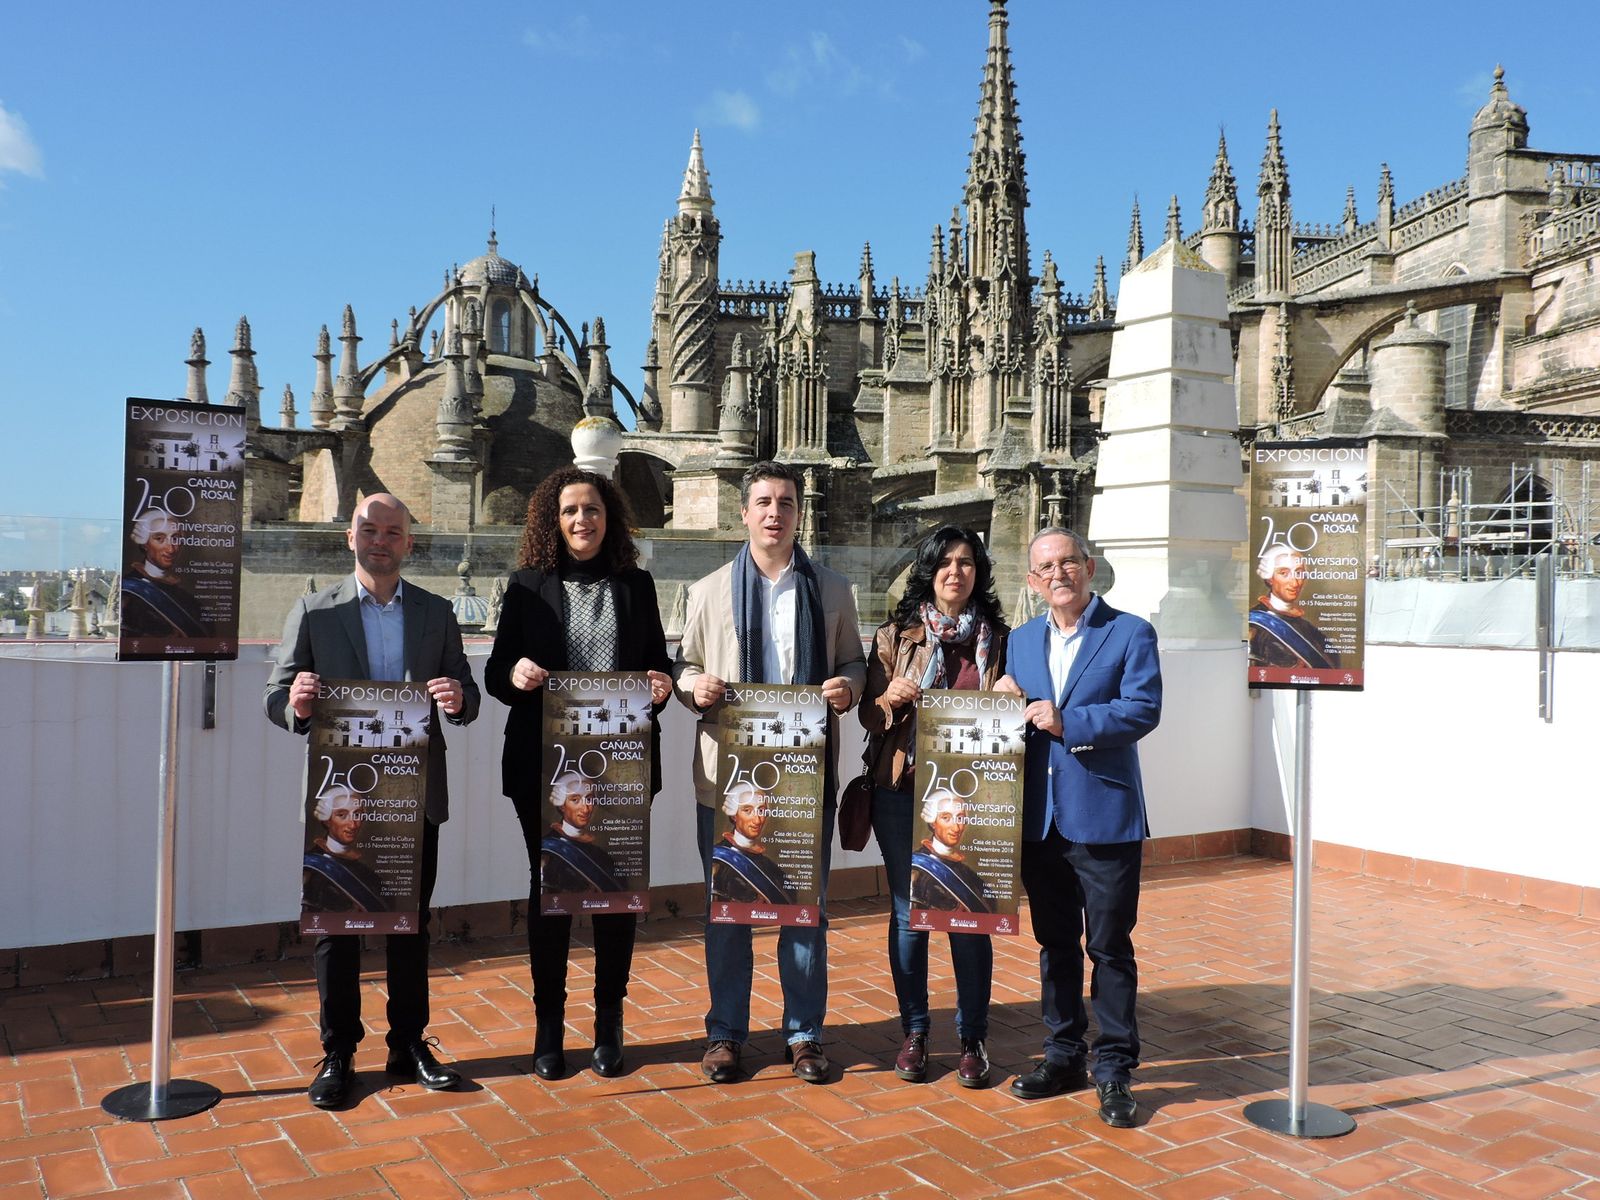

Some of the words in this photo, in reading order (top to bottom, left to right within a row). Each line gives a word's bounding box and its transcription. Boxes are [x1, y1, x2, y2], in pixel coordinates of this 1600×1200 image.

[188, 476, 236, 490] CAÑADA
[201, 490, 236, 501] ROSAL
[132, 477, 195, 532] 250
[1310, 512, 1359, 522] CAÑADA
[172, 519, 235, 533] aniversario
[1323, 524, 1358, 533] ROSAL
[1258, 516, 1317, 566] 250
[1296, 554, 1358, 566] aniversario
[548, 675, 649, 691] EXPOSICIÓN
[318, 686, 427, 702] EXPOSICIÓN
[724, 688, 824, 705] EXPOSICIÓN
[922, 695, 1022, 712] EXPOSICIÓN
[600, 740, 644, 750] CAÑADA
[371, 753, 420, 765] CAÑADA
[612, 752, 644, 760] ROSAL
[773, 752, 818, 764] CAÑADA
[384, 766, 419, 776] ROSAL
[550, 744, 607, 793] 250
[785, 764, 817, 774] ROSAL
[972, 759, 1017, 771] CAÑADA
[315, 756, 379, 808] 250
[723, 754, 780, 804] 250
[984, 772, 1016, 782] ROSAL
[586, 780, 643, 792] aniversario
[922, 761, 978, 812] 250
[354, 796, 417, 808] aniversario
[759, 792, 816, 805] aniversario
[957, 800, 1015, 813] aniversario
